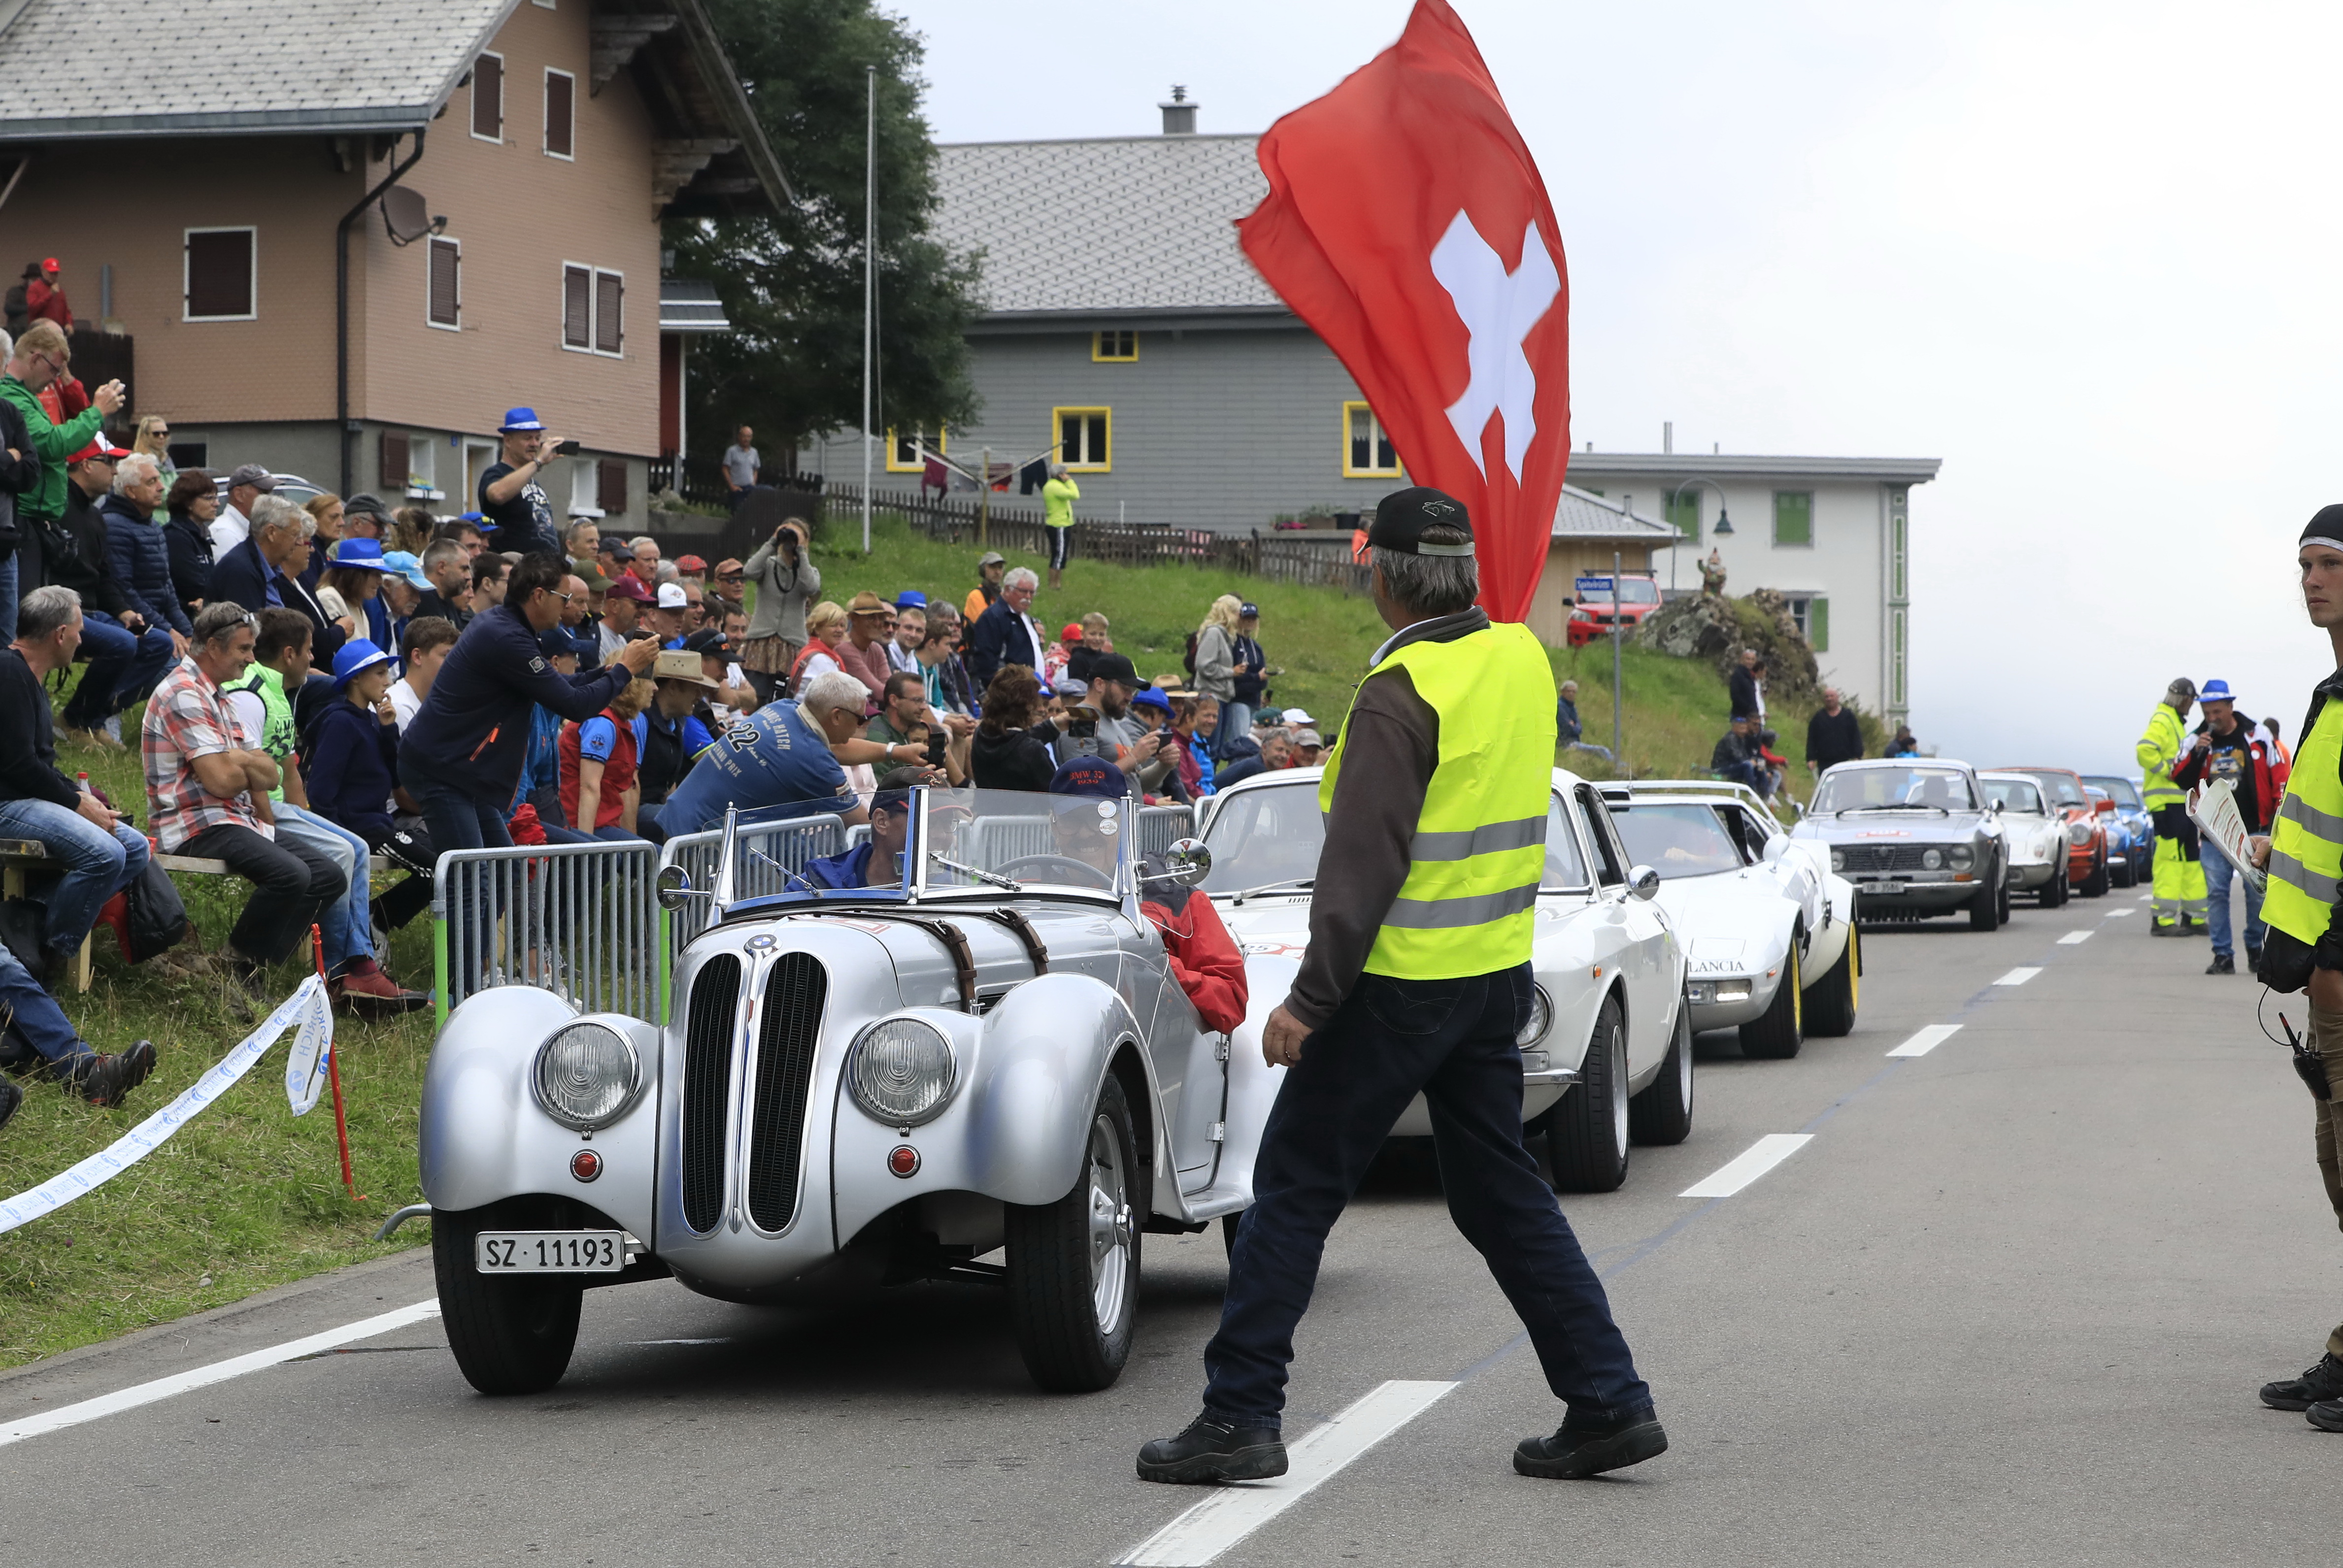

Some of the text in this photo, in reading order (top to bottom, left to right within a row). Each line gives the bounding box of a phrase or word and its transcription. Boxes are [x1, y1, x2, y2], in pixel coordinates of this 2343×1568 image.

[726, 722, 760, 753] 22
[772, 724, 791, 750] HATCH
[725, 759, 742, 777] PRIX
[1070, 770, 1090, 780] BMW
[1689, 961, 1745, 972] LANCIA
[229, 1047, 250, 1068] ZURICH
[201, 1072, 225, 1093] ZURICH
[83, 1162, 109, 1177] ZURICH
[51, 1179, 76, 1195] ZURICH
[17, 1196, 44, 1211] ZURICH
[486, 1238, 614, 1267] SZ 11193
